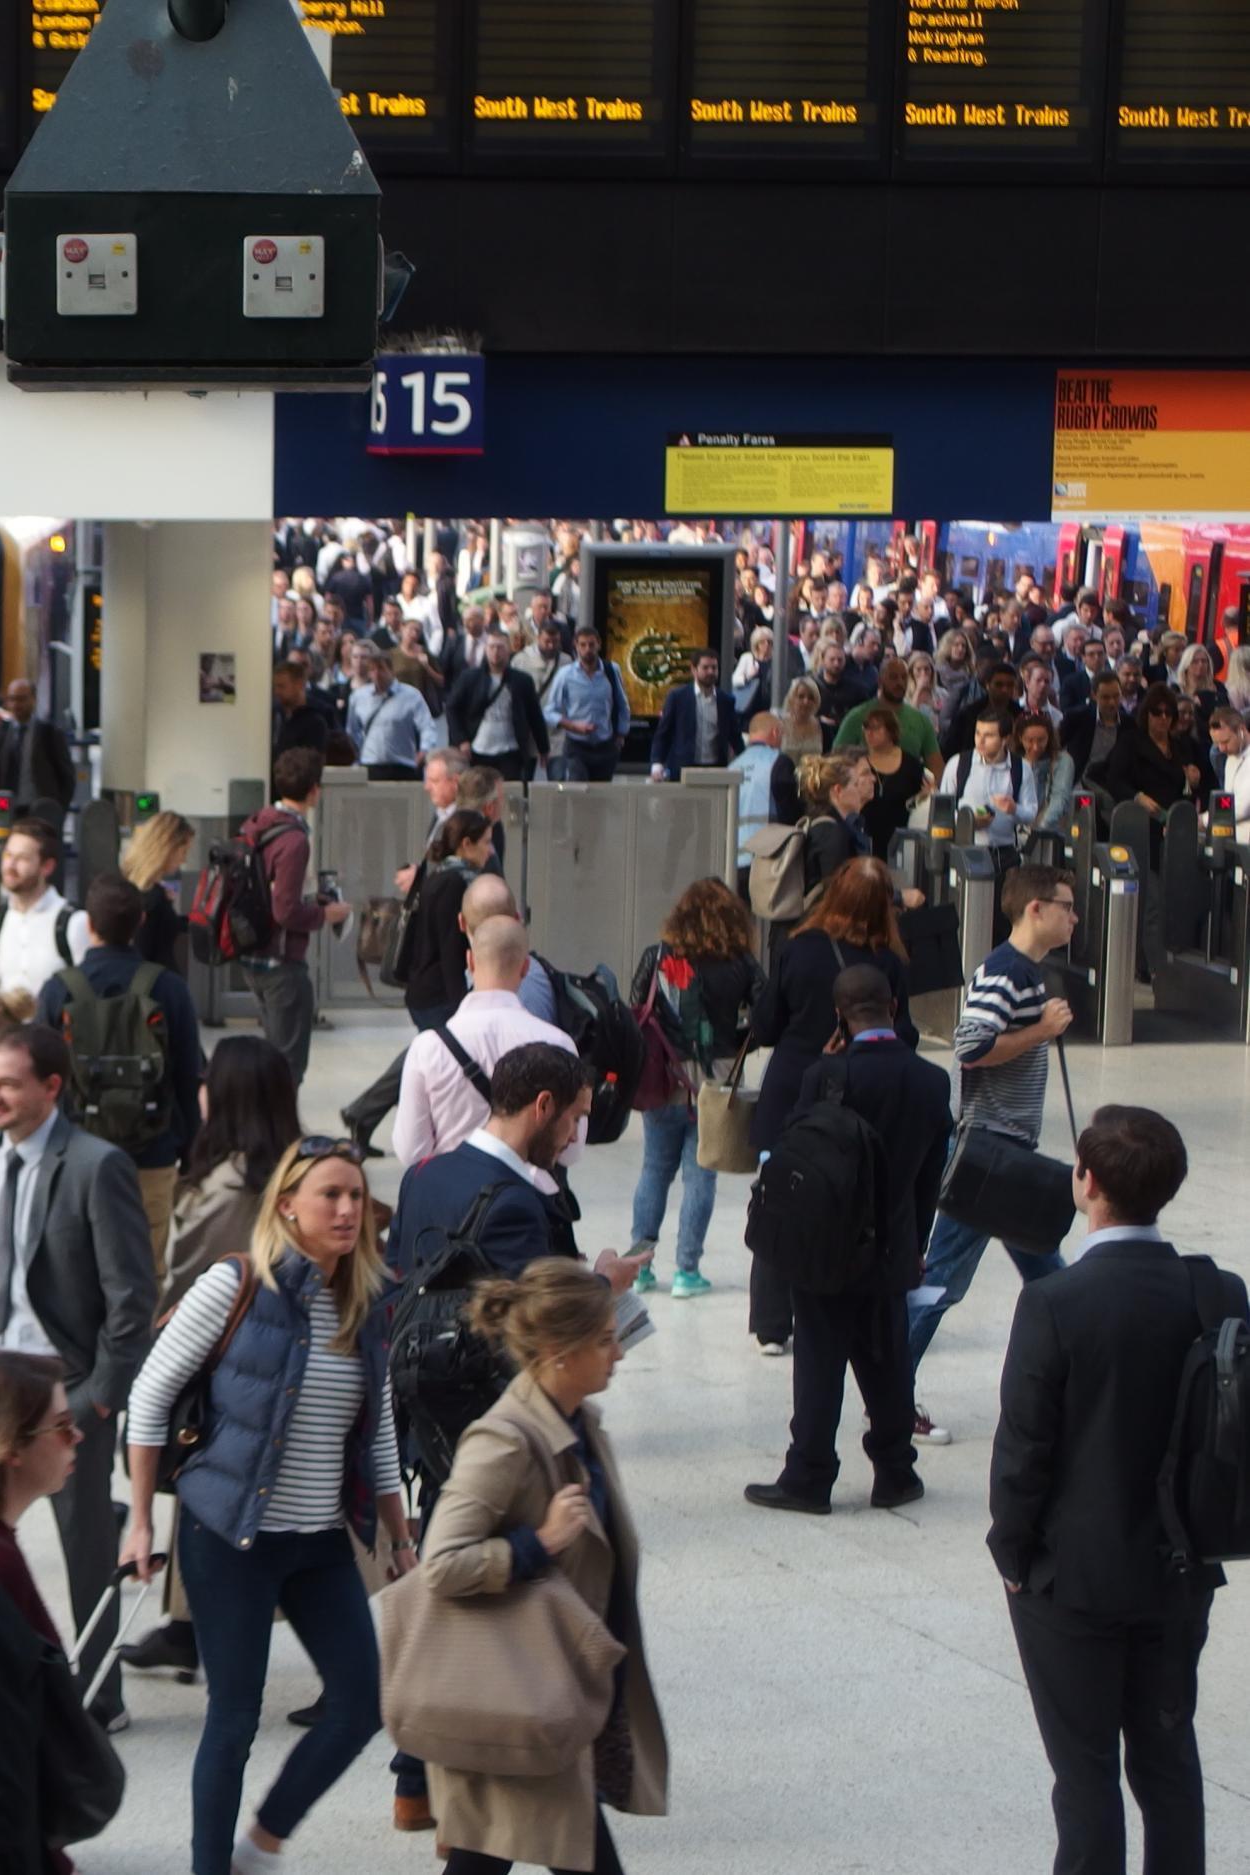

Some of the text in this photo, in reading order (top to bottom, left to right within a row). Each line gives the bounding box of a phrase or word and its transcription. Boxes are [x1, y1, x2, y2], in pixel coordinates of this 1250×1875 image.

[908, 11, 984, 27] Bracknell
[907, 29, 985, 47] Wokingham
[923, 48, 988, 67] Reading.
[367, 93, 427, 117] Trains
[474, 95, 644, 120] South West Trains
[690, 99, 858, 123] South West Trains
[905, 103, 1070, 126] South West Trains
[1118, 105, 1170, 127] South
[1176, 107, 1219, 127] West
[1058, 378, 1112, 404] BEAT THE
[401, 371, 472, 435] 15
[1056, 404, 1158, 430] RUGBY CROWDS
[698, 433, 776, 447] Penalty Fares
